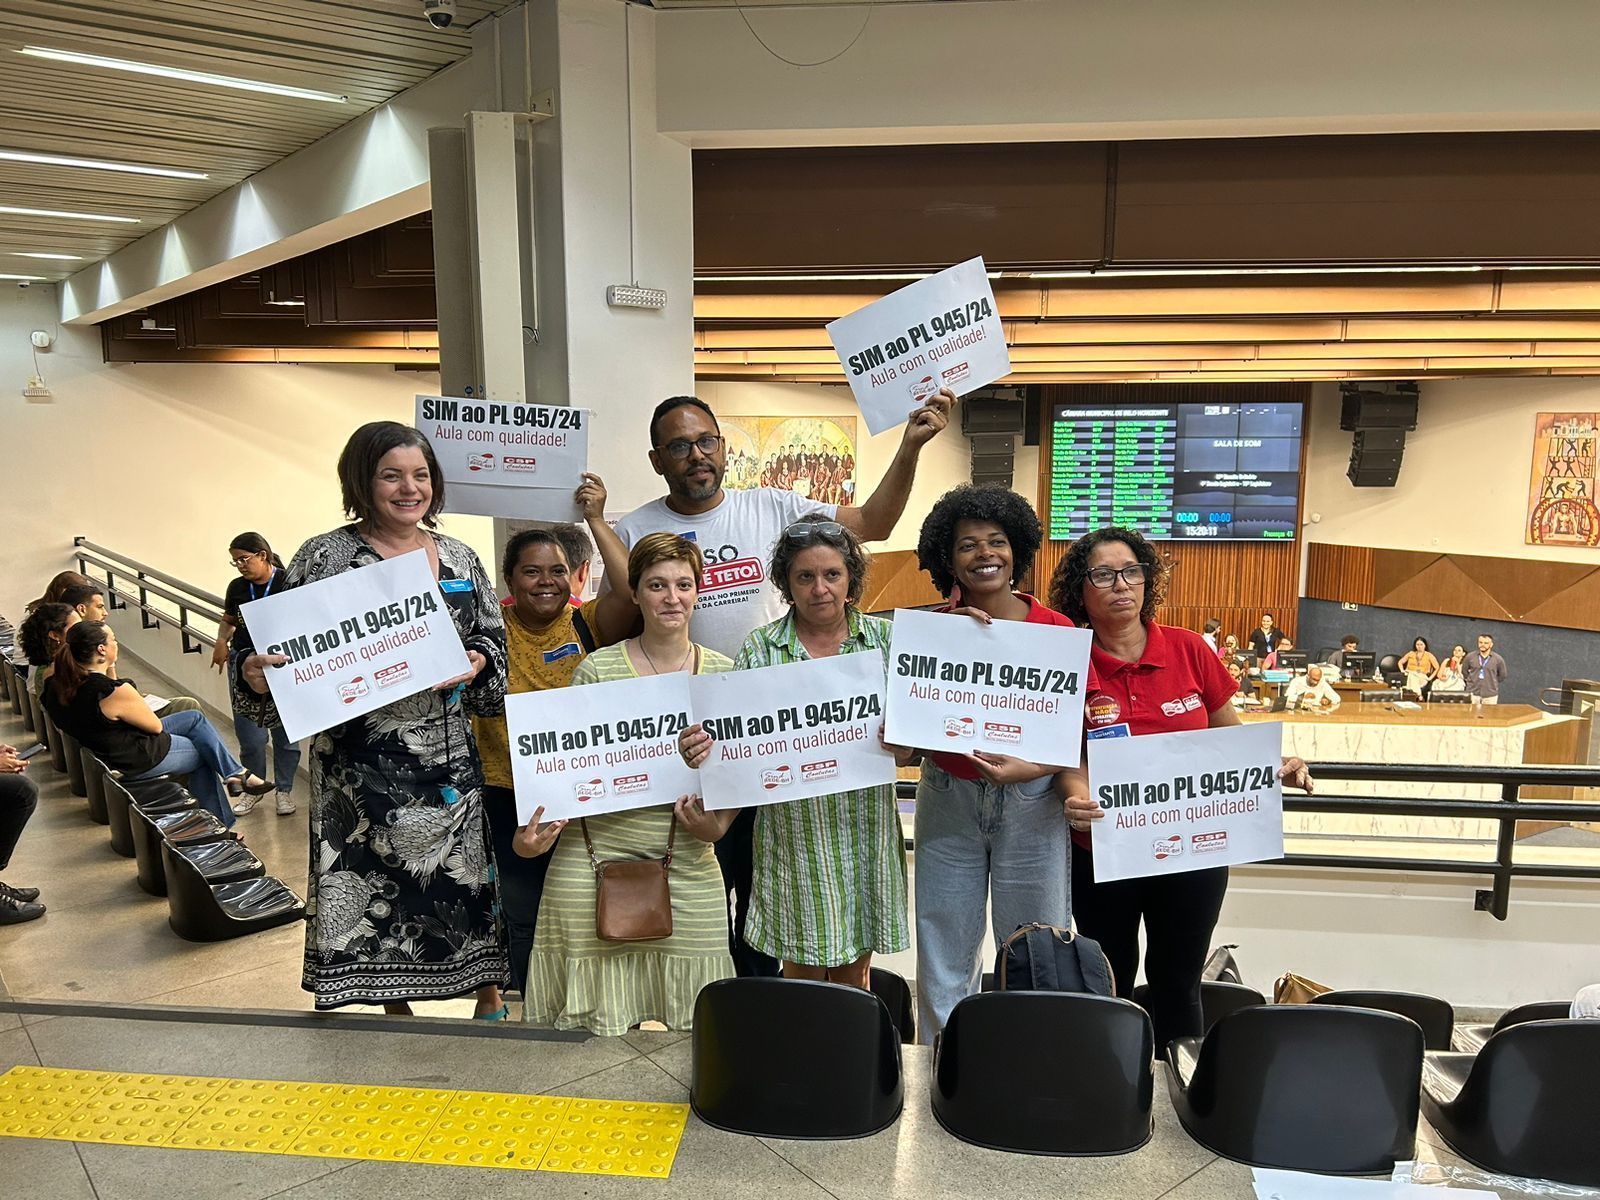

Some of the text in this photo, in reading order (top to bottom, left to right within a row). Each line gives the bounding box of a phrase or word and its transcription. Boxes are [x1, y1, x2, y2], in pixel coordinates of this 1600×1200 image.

[848, 298, 992, 375] SIM ao PL 945/24
[870, 325, 986, 388] Aula com qualidade!
[944, 364, 967, 376] CSP
[423, 399, 581, 430] SIM ao PL 945/24
[435, 425, 566, 447] Aula com qualidade!
[1213, 439, 1262, 448] SALA DE SOM
[1176, 512, 1232, 523] 00:00 00:00
[703, 544, 739, 565] SO
[704, 570, 712, 586] É
[715, 563, 758, 583] TETO!
[698, 595, 715, 603] GRAL
[730, 588, 759, 597] PRIMEIRO
[714, 596, 748, 606] CARREIRA!
[313, 629, 340, 654] ao
[340, 619, 366, 644] PL
[366, 592, 438, 634] 945/24
[293, 621, 432, 685] Aula com qualidade!
[377, 664, 406, 677] CSP
[897, 653, 1078, 695] SIM ao PL 945/24
[910, 682, 1059, 714] Aula com qualidade!
[702, 694, 881, 741] SIM ao PL 945/24
[987, 724, 1019, 732] CSP
[518, 712, 689, 756] SIM ao PL 945/24
[721, 723, 868, 761] Aula com qualidade!
[536, 740, 678, 774] Aula com qualidade!
[804, 761, 834, 770] CSP
[616, 775, 646, 784] CSP
[806, 769, 834, 778] Conlutas
[618, 783, 646, 791] Conlutas
[1099, 766, 1274, 809] SIM ao PL 945/24
[1116, 795, 1259, 829] Aula com qualidade!
[1195, 833, 1224, 841] CSP
